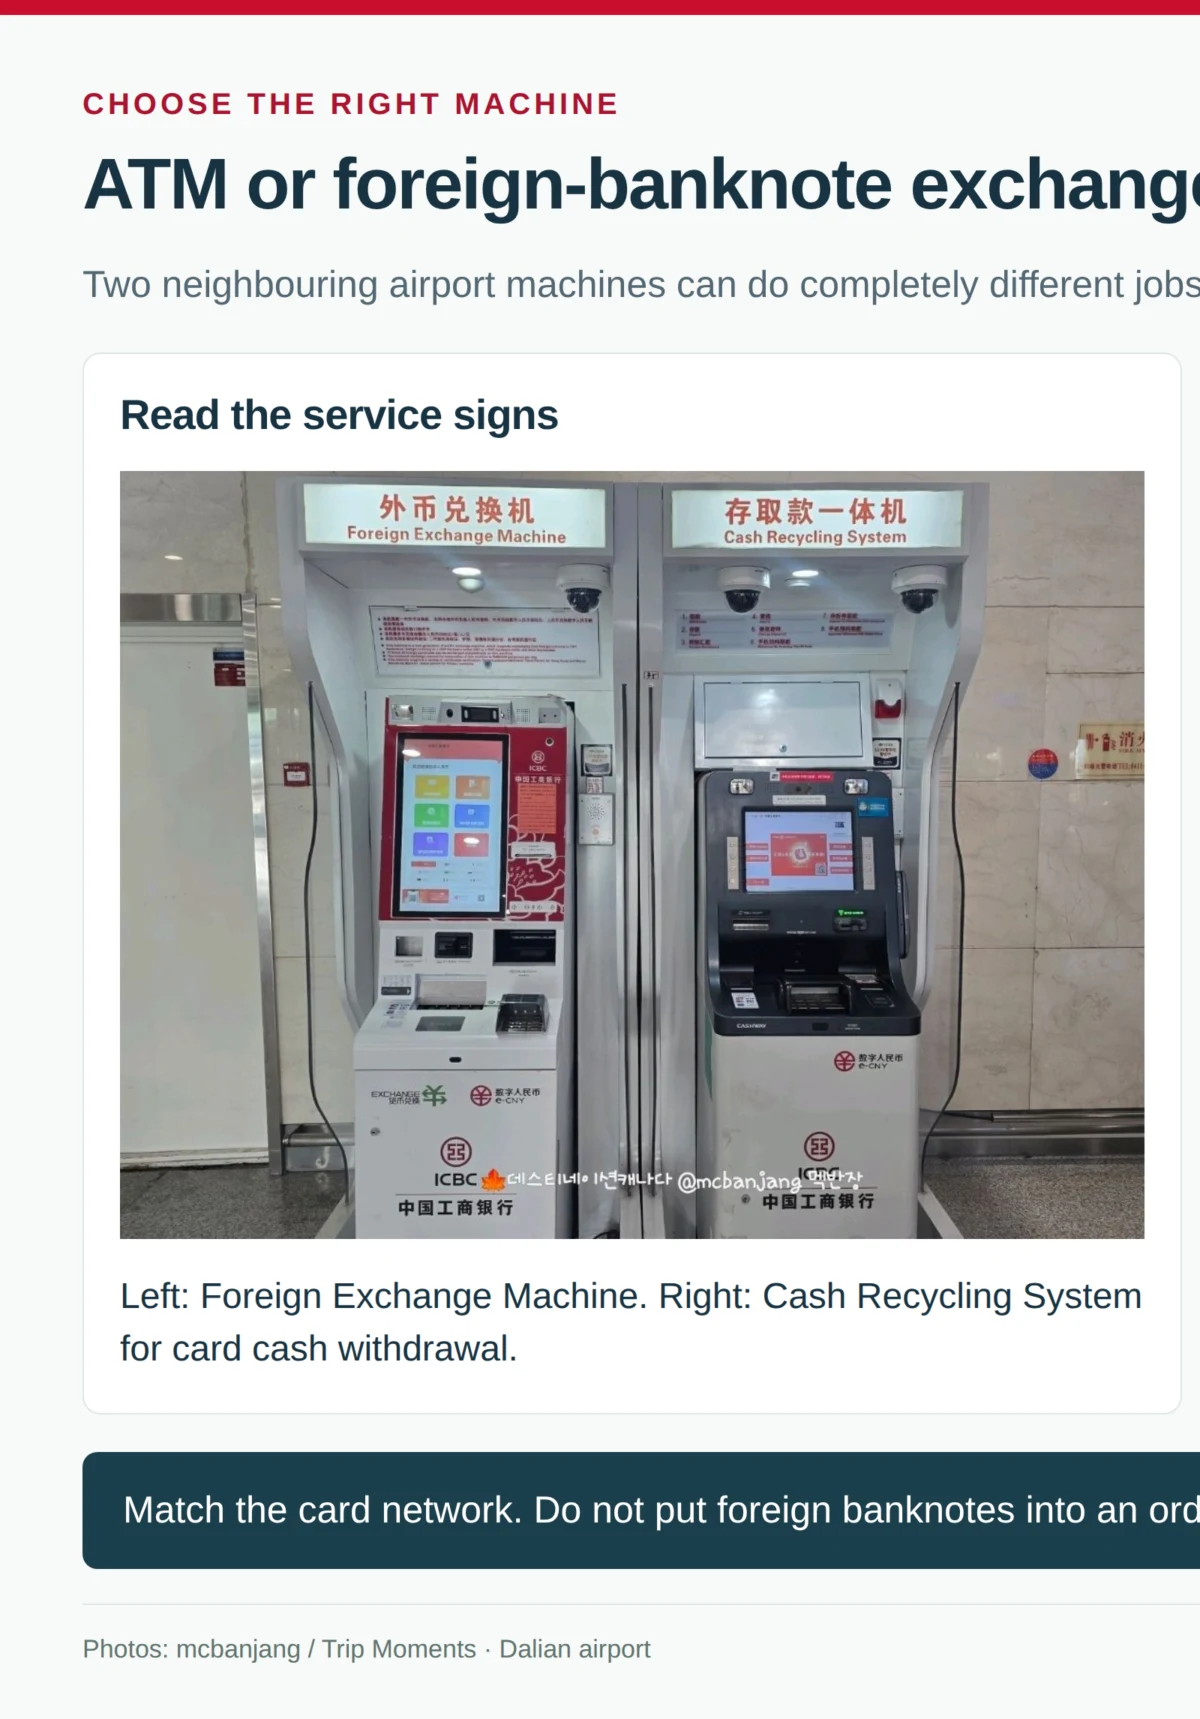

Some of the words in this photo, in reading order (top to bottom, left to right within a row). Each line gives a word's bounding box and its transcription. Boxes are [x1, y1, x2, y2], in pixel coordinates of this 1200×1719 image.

[379, 494, 535, 525] 外币兑换机
[725, 497, 908, 525] 存取款一体机
[346, 525, 409, 543] Foreign
[414, 526, 493, 546] Exchange
[497, 528, 567, 544] Machine
[724, 529, 763, 545] Cash
[767, 529, 843, 547] Recycling
[847, 529, 908, 547] System
[858, 1053, 904, 1063] 数字人民币
[858, 1062, 888, 1070] e-CNY
[371, 1090, 421, 1098] EXCHANGE
[495, 1087, 541, 1097] 数字人民币
[495, 1096, 525, 1104] e-CNY
[434, 1172, 478, 1187] ICBC
[398, 1198, 514, 1217] 中国工商银行
[762, 1192, 875, 1210] 中国工商银行
